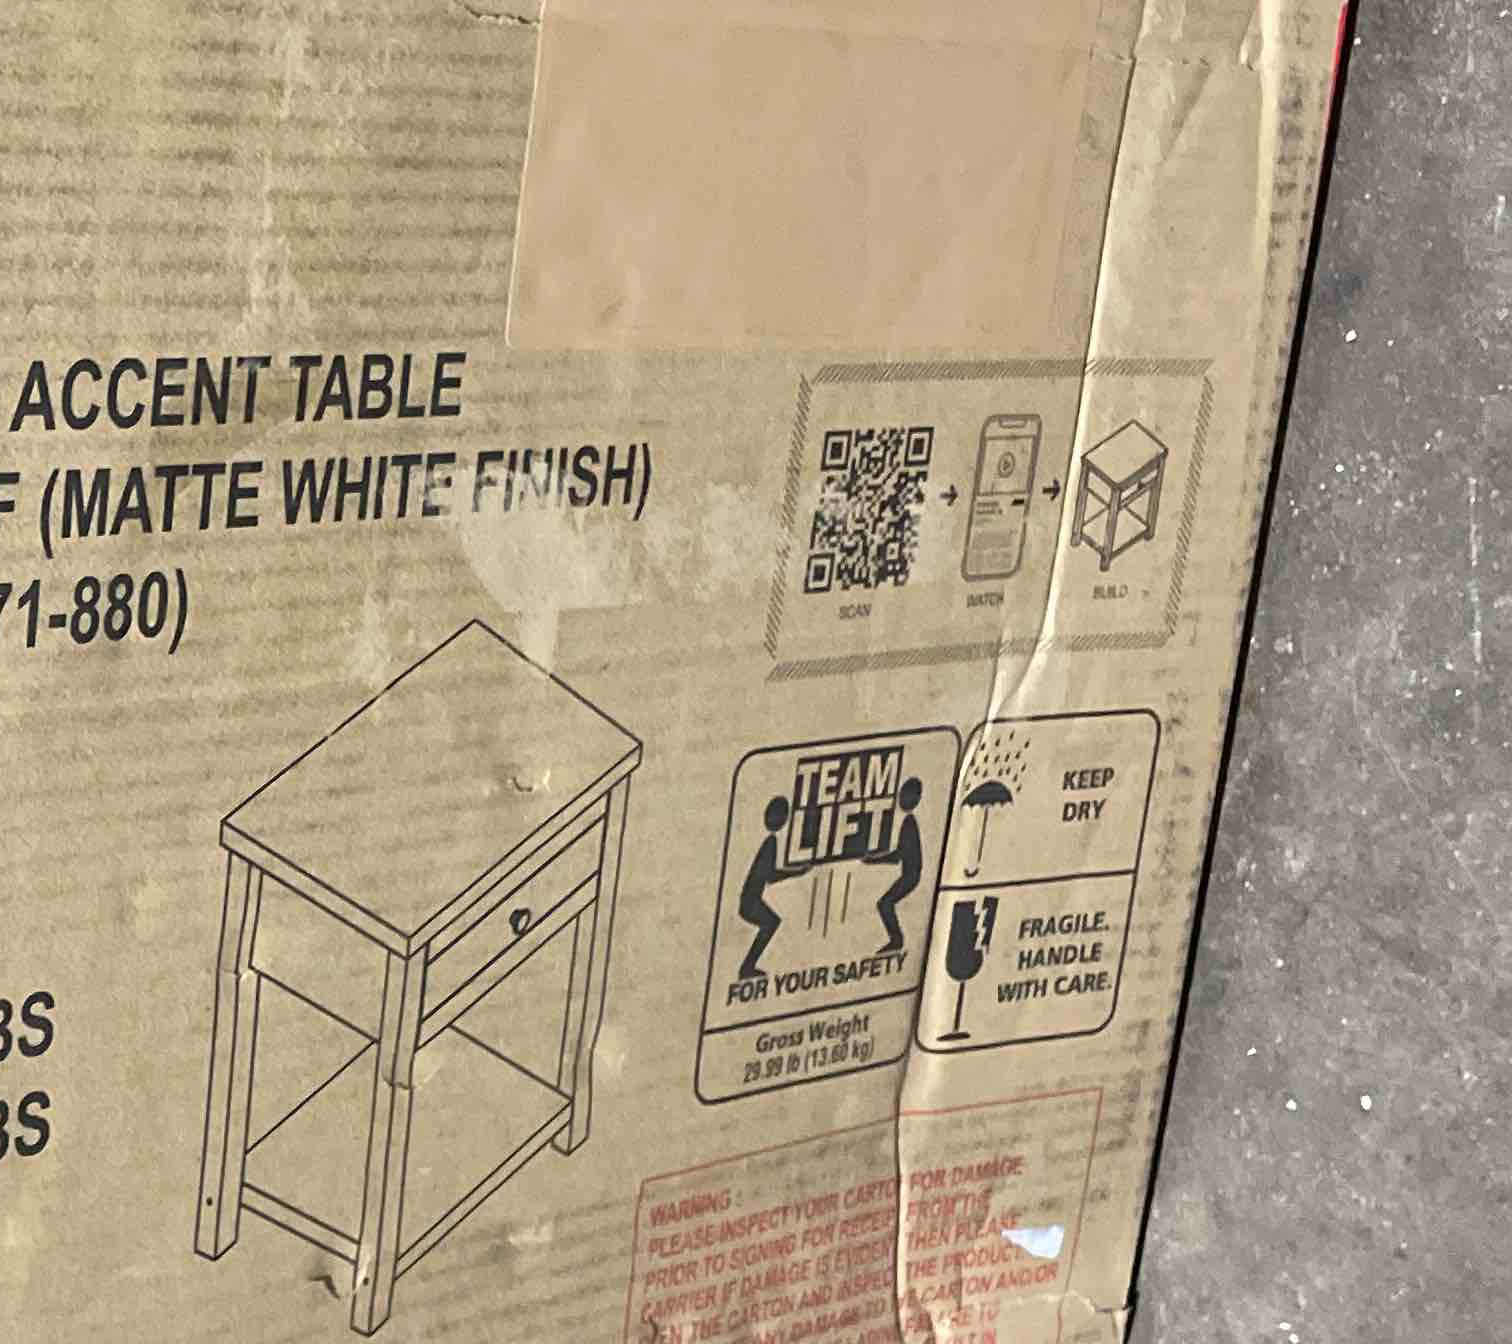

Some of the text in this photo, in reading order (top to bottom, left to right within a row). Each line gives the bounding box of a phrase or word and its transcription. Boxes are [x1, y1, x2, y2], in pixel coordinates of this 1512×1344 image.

[10, 356, 272, 432] ACCENT
[290, 352, 466, 421] TABLE
[41, 461, 262, 559] (MATTE
[283, 452, 456, 524] WHITE
[471, 443, 652, 521] FINISH)
[839, 584, 1129, 620] SCAN WATCH BUILD
[794, 752, 900, 809] TEAM
[1063, 767, 1115, 791] KEEP
[1062, 798, 1107, 822] DRY
[787, 798, 894, 865] LIFT
[1018, 911, 1111, 940] FRAGILE.
[1017, 942, 1104, 971] HANDLE
[726, 952, 908, 1007] FOR YOUR SAFETY
[997, 971, 1113, 1004] WITH CARE.
[755, 1013, 871, 1055] Gross Weight
[743, 1055, 785, 1084] 29.99
[786, 1054, 800, 1075] lb
[648, 1224, 715, 1258] PLEASE
[720, 1205, 790, 1240] INSPECT
[843, 1177, 899, 1207] CARTO
[951, 1156, 1026, 1184] DAMAGE
[645, 1261, 699, 1288] PRIOR
[703, 1254, 726, 1278] TO
[729, 1233, 798, 1272] SIGNING
[801, 1222, 836, 1251] FOR
